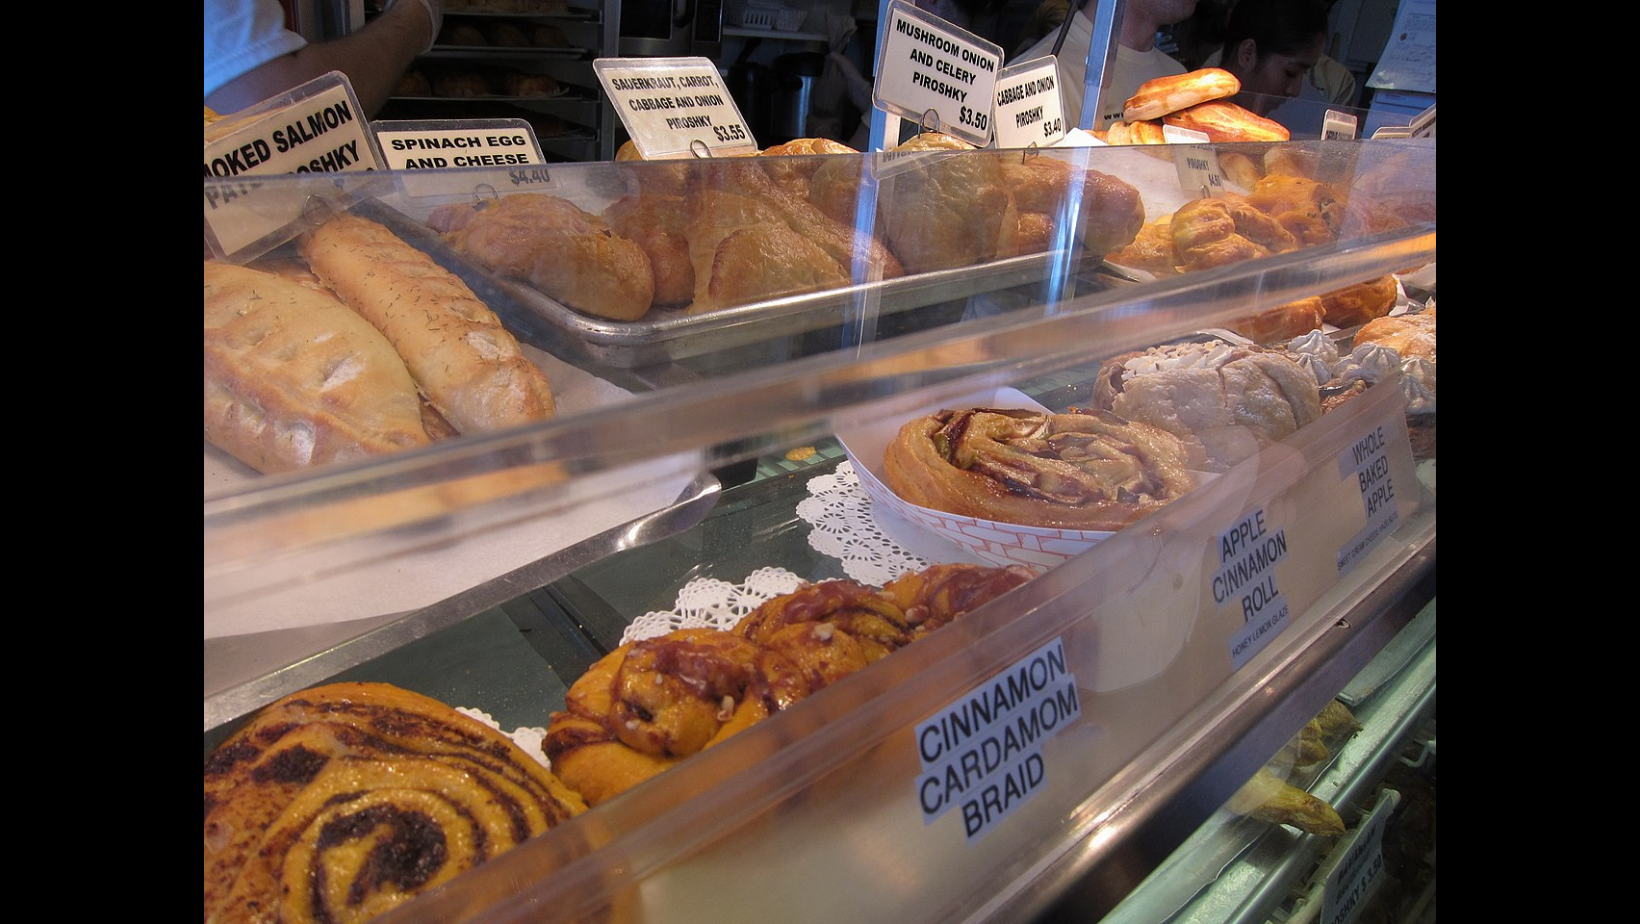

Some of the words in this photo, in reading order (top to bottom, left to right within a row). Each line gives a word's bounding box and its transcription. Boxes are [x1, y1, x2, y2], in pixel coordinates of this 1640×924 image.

[896, 19, 960, 58] MUSHROOM
[962, 50, 995, 73] ONION
[611, 76, 680, 91] SAUERKRAUT,
[680, 75, 719, 89] CARROT,
[910, 49, 934, 68] AND
[936, 59, 977, 86] CELERY
[628, 97, 676, 112] CABBAGE
[676, 96, 695, 109] AND
[695, 94, 725, 107] ONION
[912, 71, 968, 103] PIROSHKY
[997, 84, 1025, 107] CABBAGE
[1024, 81, 1037, 98] AND
[1036, 75, 1055, 93] ONION
[272, 100, 353, 154] SALMON
[665, 115, 713, 130] PIROSHKY
[712, 124, 746, 143] $3.55
[959, 106, 988, 131] $3.50
[1015, 105, 1044, 129] PIROSHKY
[1043, 117, 1062, 138] $3.40
[287, 139, 360, 175] SHKY
[391, 136, 482, 151] SPINACH
[486, 135, 527, 147] EGG
[405, 157, 448, 170] AND
[453, 153, 530, 167] CHEESE
[508, 168, 550, 187] $4.40
[1352, 425, 1385, 466] WHOLE
[1358, 455, 1389, 493] BAKED
[1367, 479, 1395, 518] APPLE
[1221, 509, 1267, 563] APPLE
[1212, 529, 1288, 604] CINNAMON
[1241, 576, 1279, 622] ROLL
[1231, 634, 1252, 659] HONEY
[1252, 618, 1272, 641] LEMON
[1271, 604, 1289, 625] GLAZE
[919, 644, 1067, 763] CINNAMON
[919, 682, 1078, 815] CARDAMOM
[961, 752, 1045, 838] BRAID
